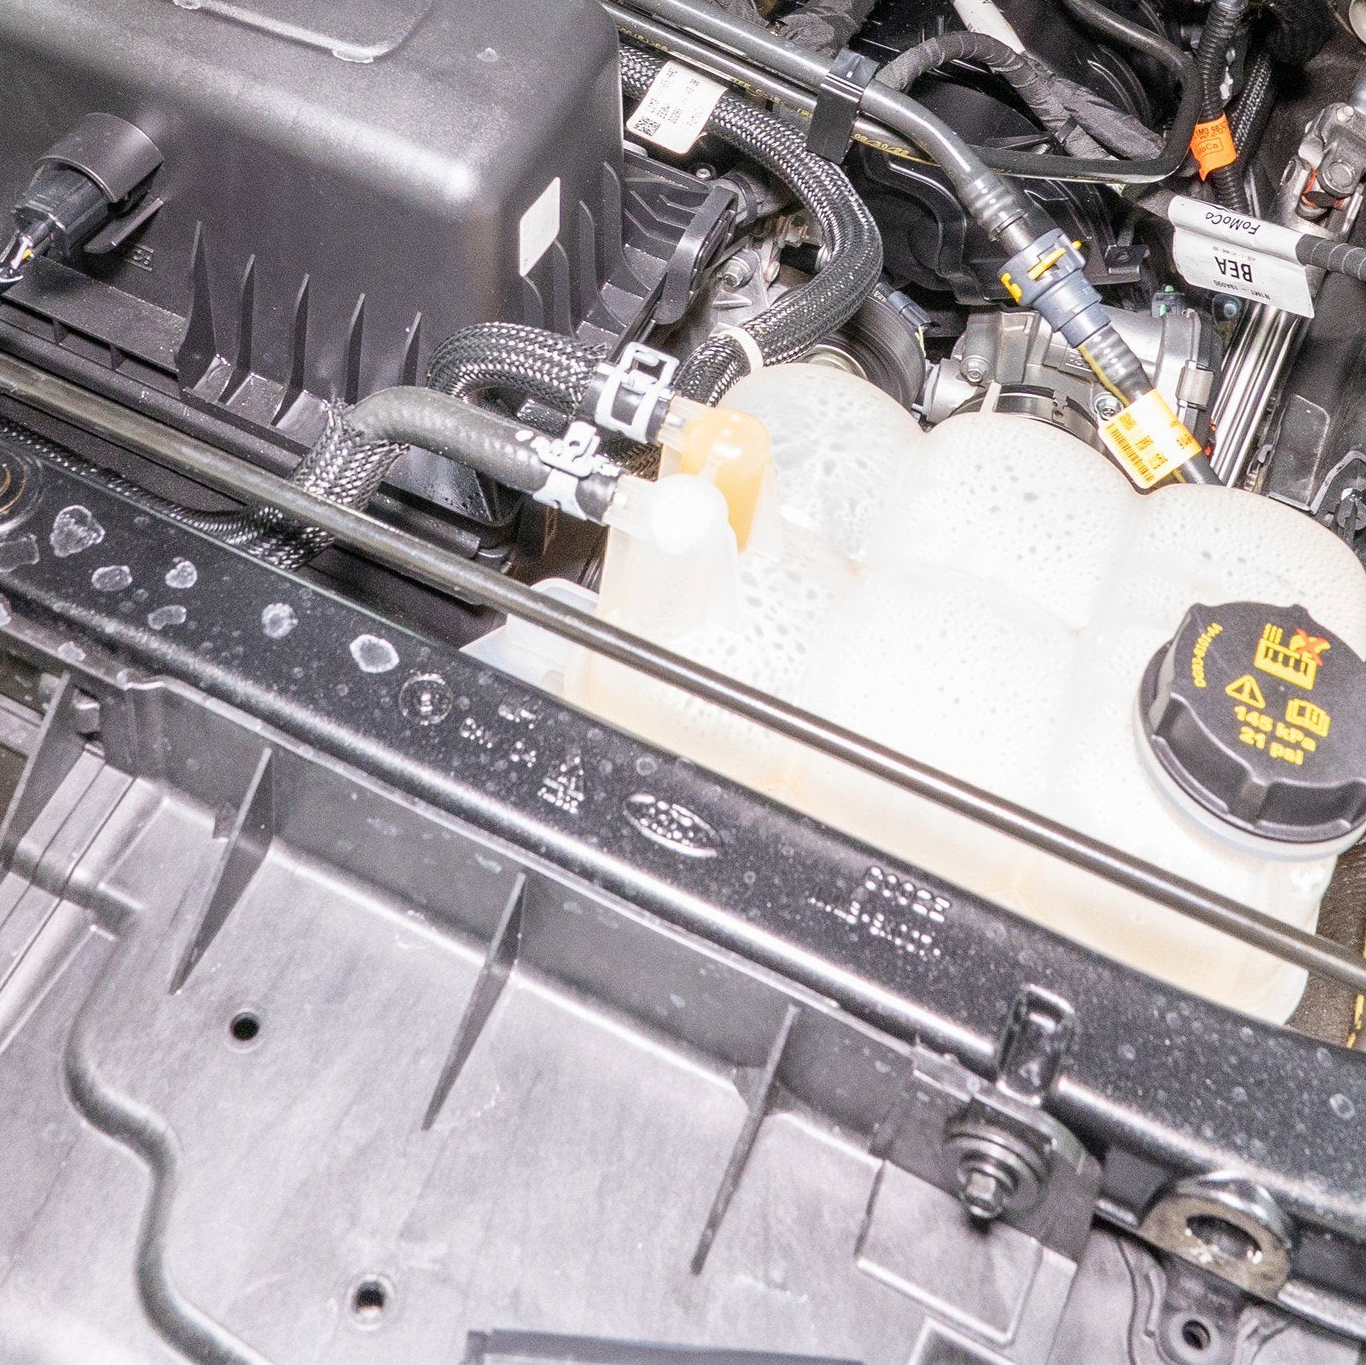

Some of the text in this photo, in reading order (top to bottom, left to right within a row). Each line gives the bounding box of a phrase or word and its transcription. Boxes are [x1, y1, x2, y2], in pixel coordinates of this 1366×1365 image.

[1204, 210, 1260, 235] FoMoCo
[1213, 255, 1252, 283] BEA
[1233, 705, 1317, 752] 145 kPa
[1237, 725, 1305, 765] 21 psi
